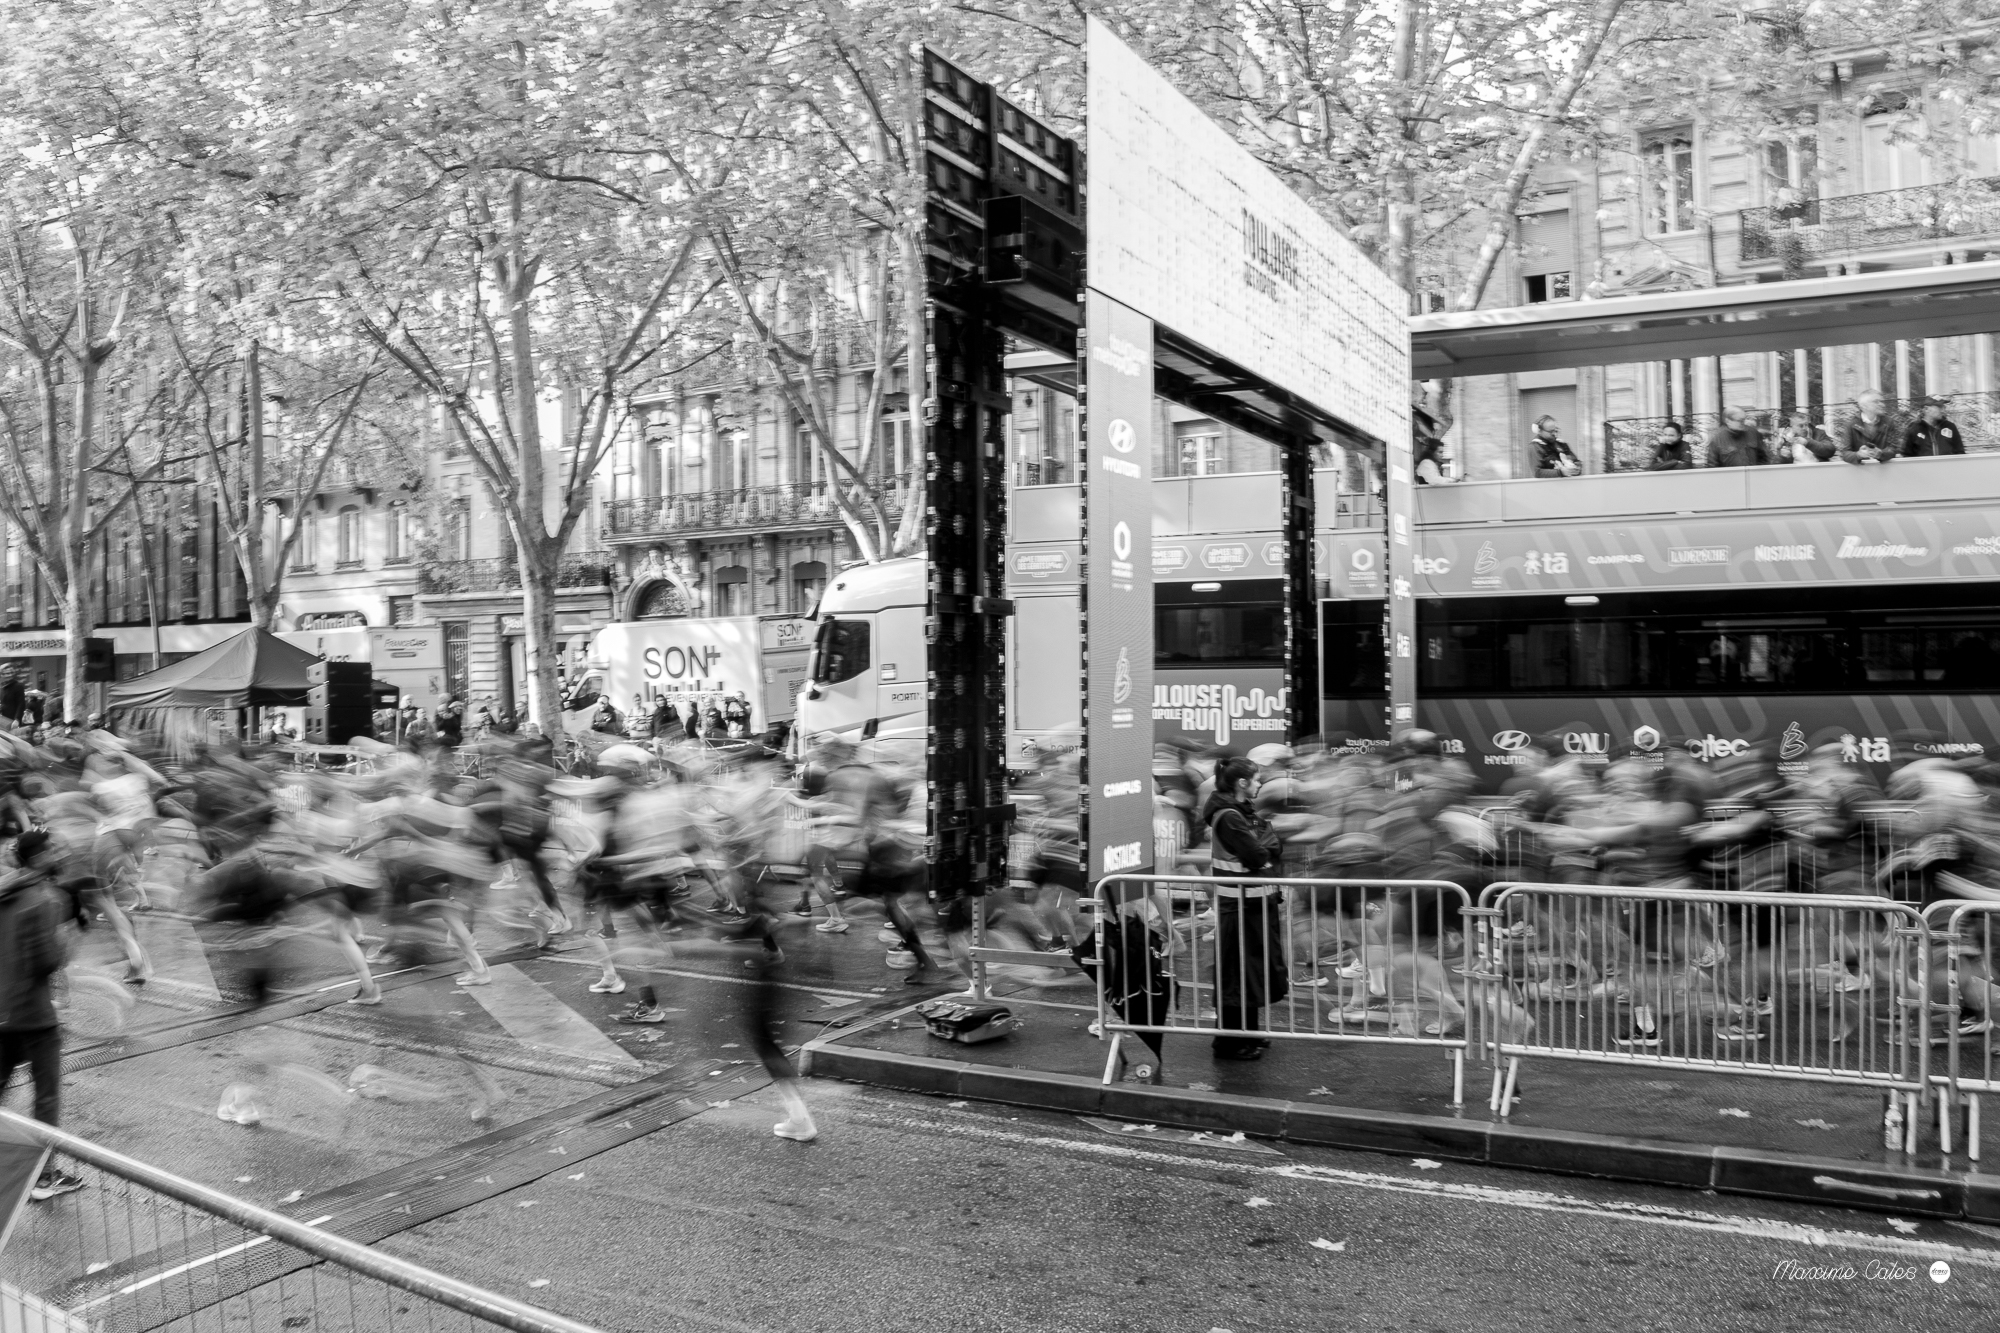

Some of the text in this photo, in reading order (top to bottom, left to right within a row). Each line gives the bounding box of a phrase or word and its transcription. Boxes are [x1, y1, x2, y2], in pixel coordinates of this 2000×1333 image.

[1586, 553, 1646, 565] CAMPUS
[1754, 544, 1816, 563] NOSTALGIE
[1913, 742, 1985, 754] CAMPUS
